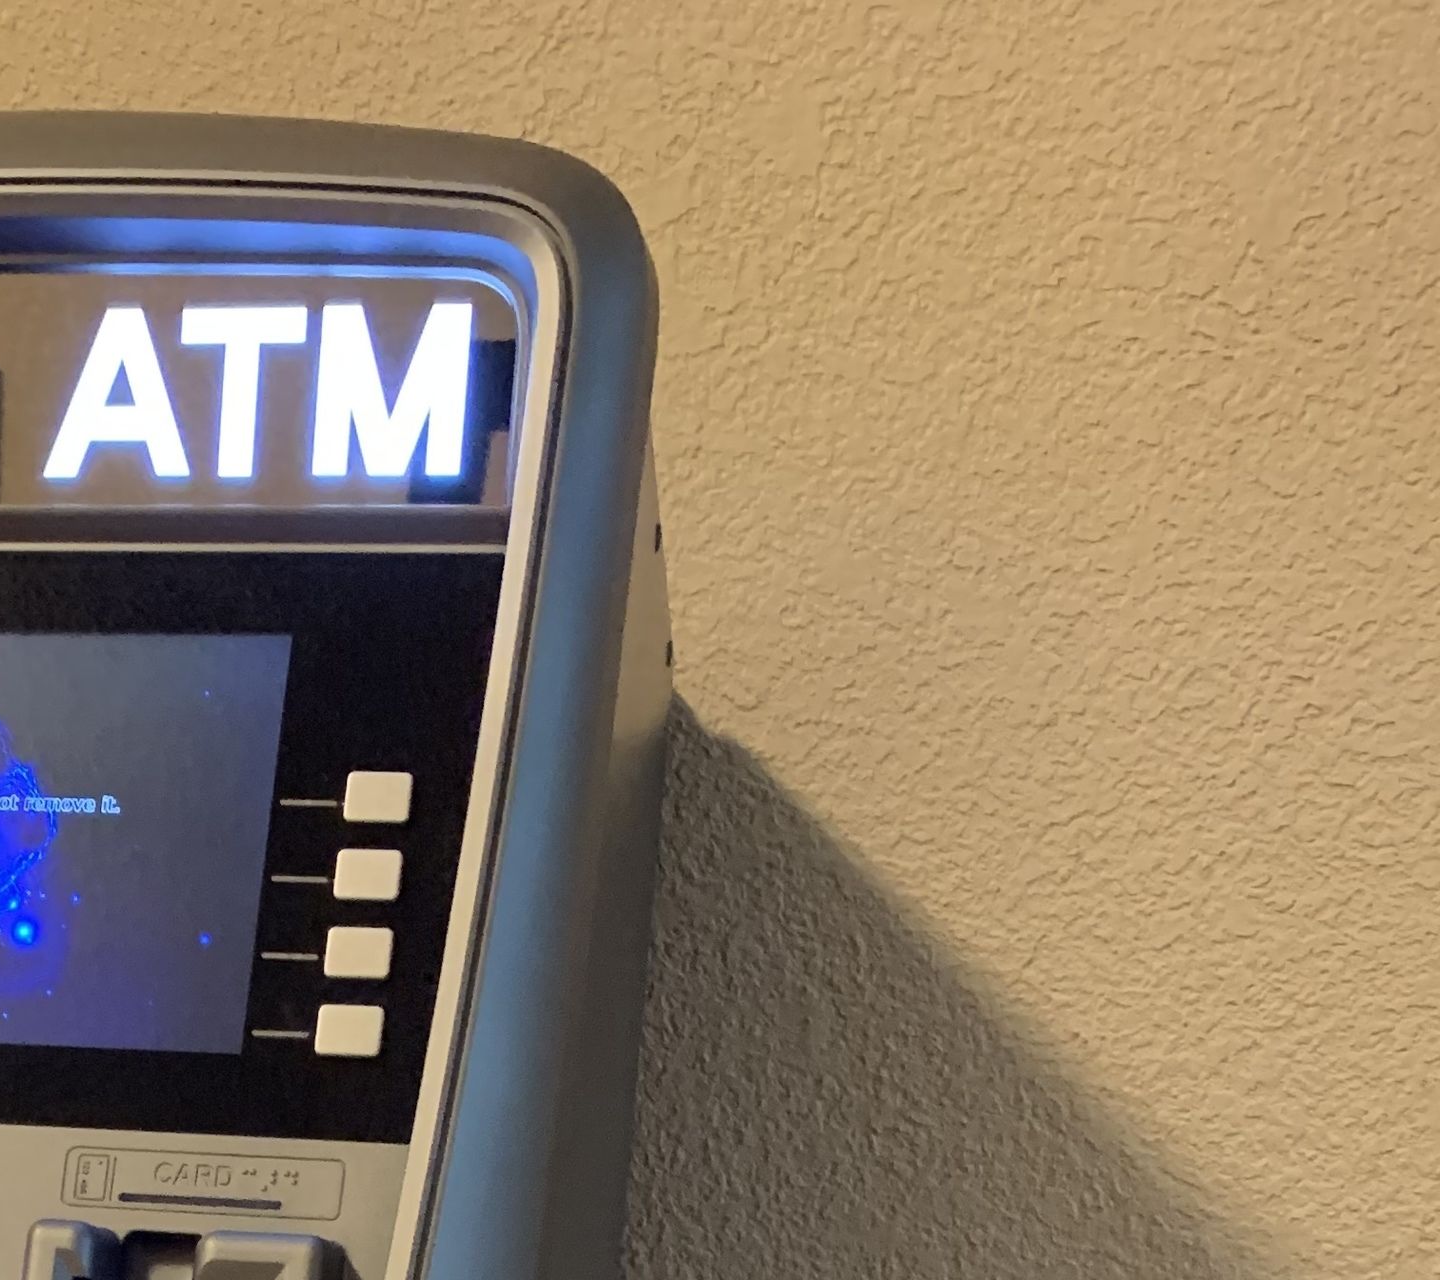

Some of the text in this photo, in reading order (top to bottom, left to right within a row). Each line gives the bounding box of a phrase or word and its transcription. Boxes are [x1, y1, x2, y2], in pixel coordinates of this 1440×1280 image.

[42, 302, 474, 480] ATM
[24, 796, 96, 813] remove
[101, 795, 121, 814] it.
[153, 1161, 233, 1188] CARD
